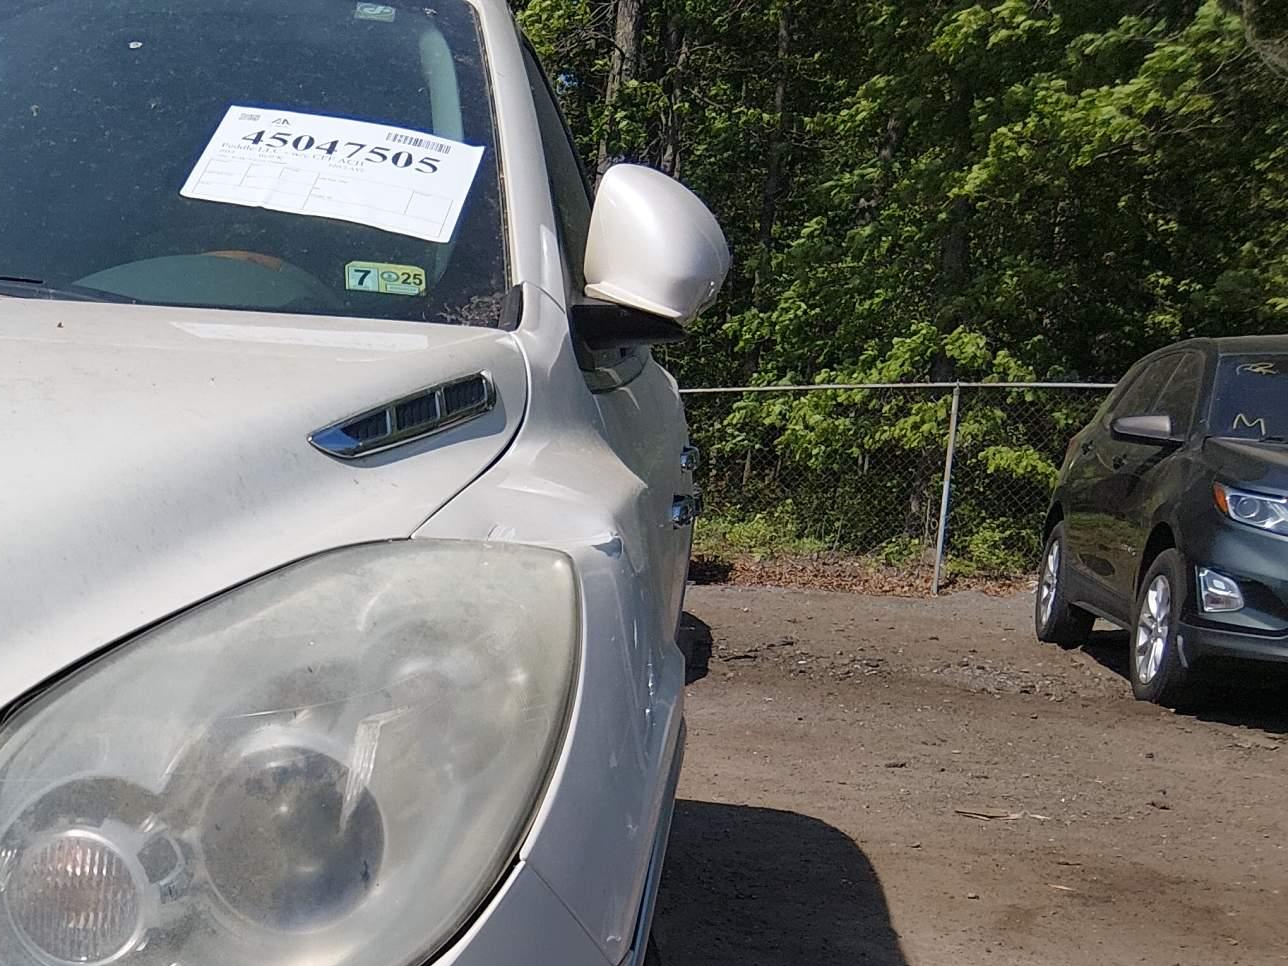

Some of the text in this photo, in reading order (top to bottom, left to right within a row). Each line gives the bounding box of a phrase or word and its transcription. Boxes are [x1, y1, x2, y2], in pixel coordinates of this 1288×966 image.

[241, 130, 441, 174] 45047505
[354, 269, 371, 286] 7
[400, 272, 423, 286] 25
